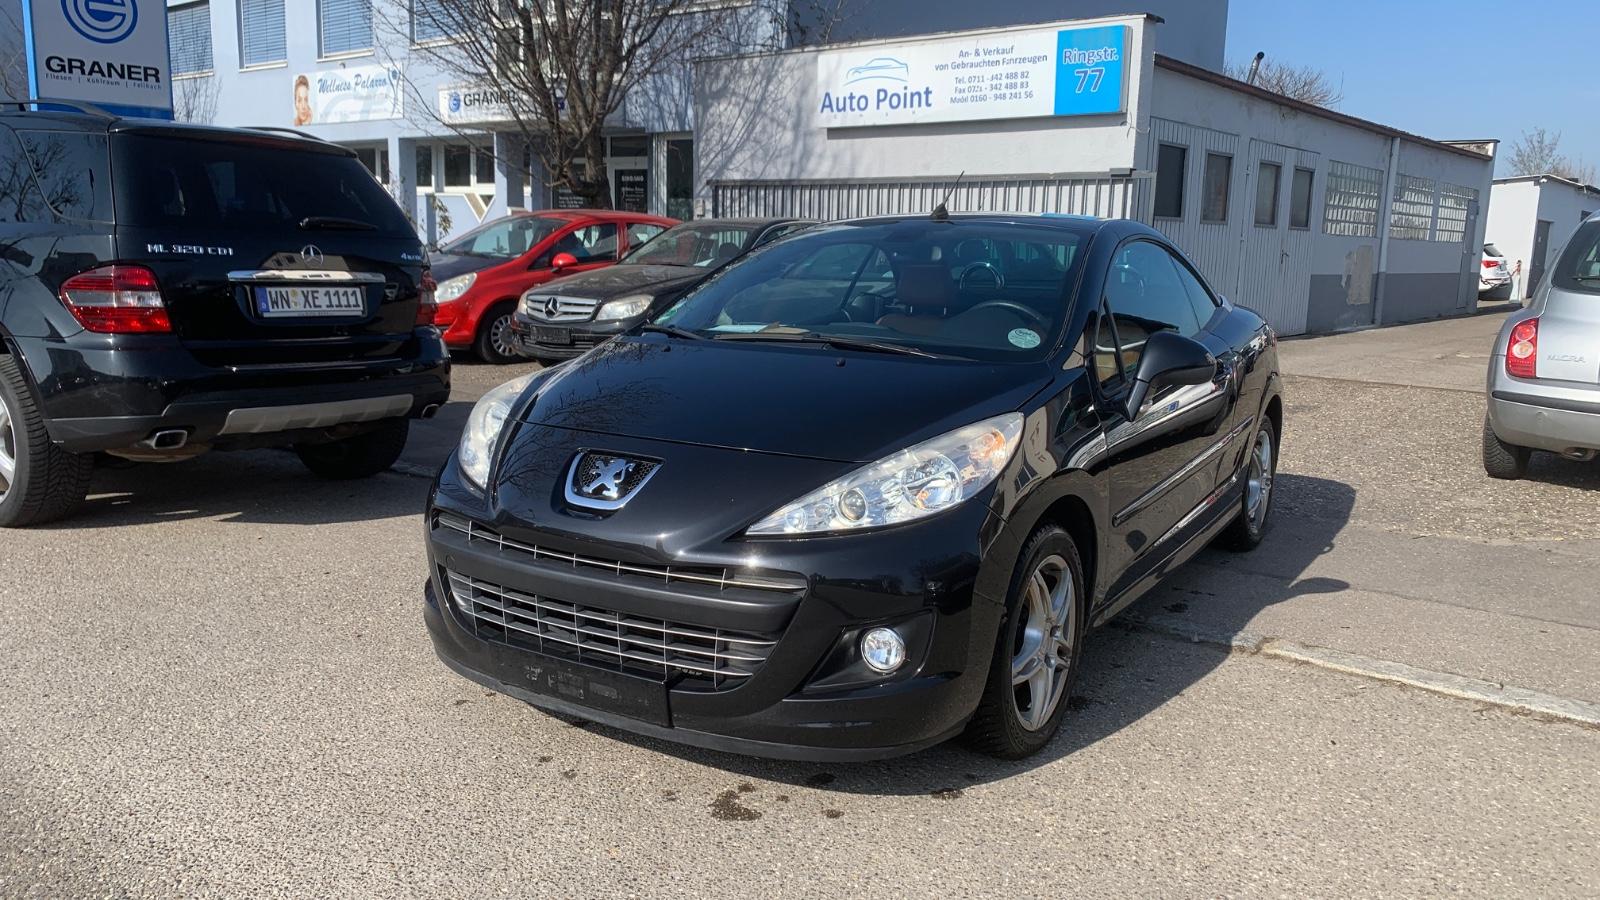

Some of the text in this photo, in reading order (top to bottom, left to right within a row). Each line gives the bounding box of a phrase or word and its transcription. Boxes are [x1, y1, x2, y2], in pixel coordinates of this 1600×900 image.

[958, 45, 1015, 59] An- & Verkauf
[1063, 46, 1119, 66] Ringstr.
[45, 55, 161, 83] GRANER
[934, 62, 949, 71] von
[950, 58, 1001, 70] Gebrauchten
[954, 76, 967, 85] Tel.
[967, 75, 985, 83] 0711
[1004, 72, 1019, 80] 488
[1020, 71, 1030, 79] 82
[1075, 67, 1105, 93] 77
[317, 78, 351, 95] Wellness
[954, 86, 966, 94] Fax
[989, 83, 1003, 91] 342
[1004, 82, 1018, 90] 488
[1020, 81, 1029, 89] 83
[819, 85, 933, 114] Auto Point
[969, 94, 988, 103] 0160
[993, 92, 1007, 101] 948
[1008, 92, 1022, 100] 241
[1024, 90, 1034, 99] 56
[147, 243, 234, 256] ML 320 CDI
[268, 290, 291, 310] WN
[301, 289, 323, 308] XE
[324, 289, 361, 308] 1111
[1546, 354, 1587, 363] MICRA
